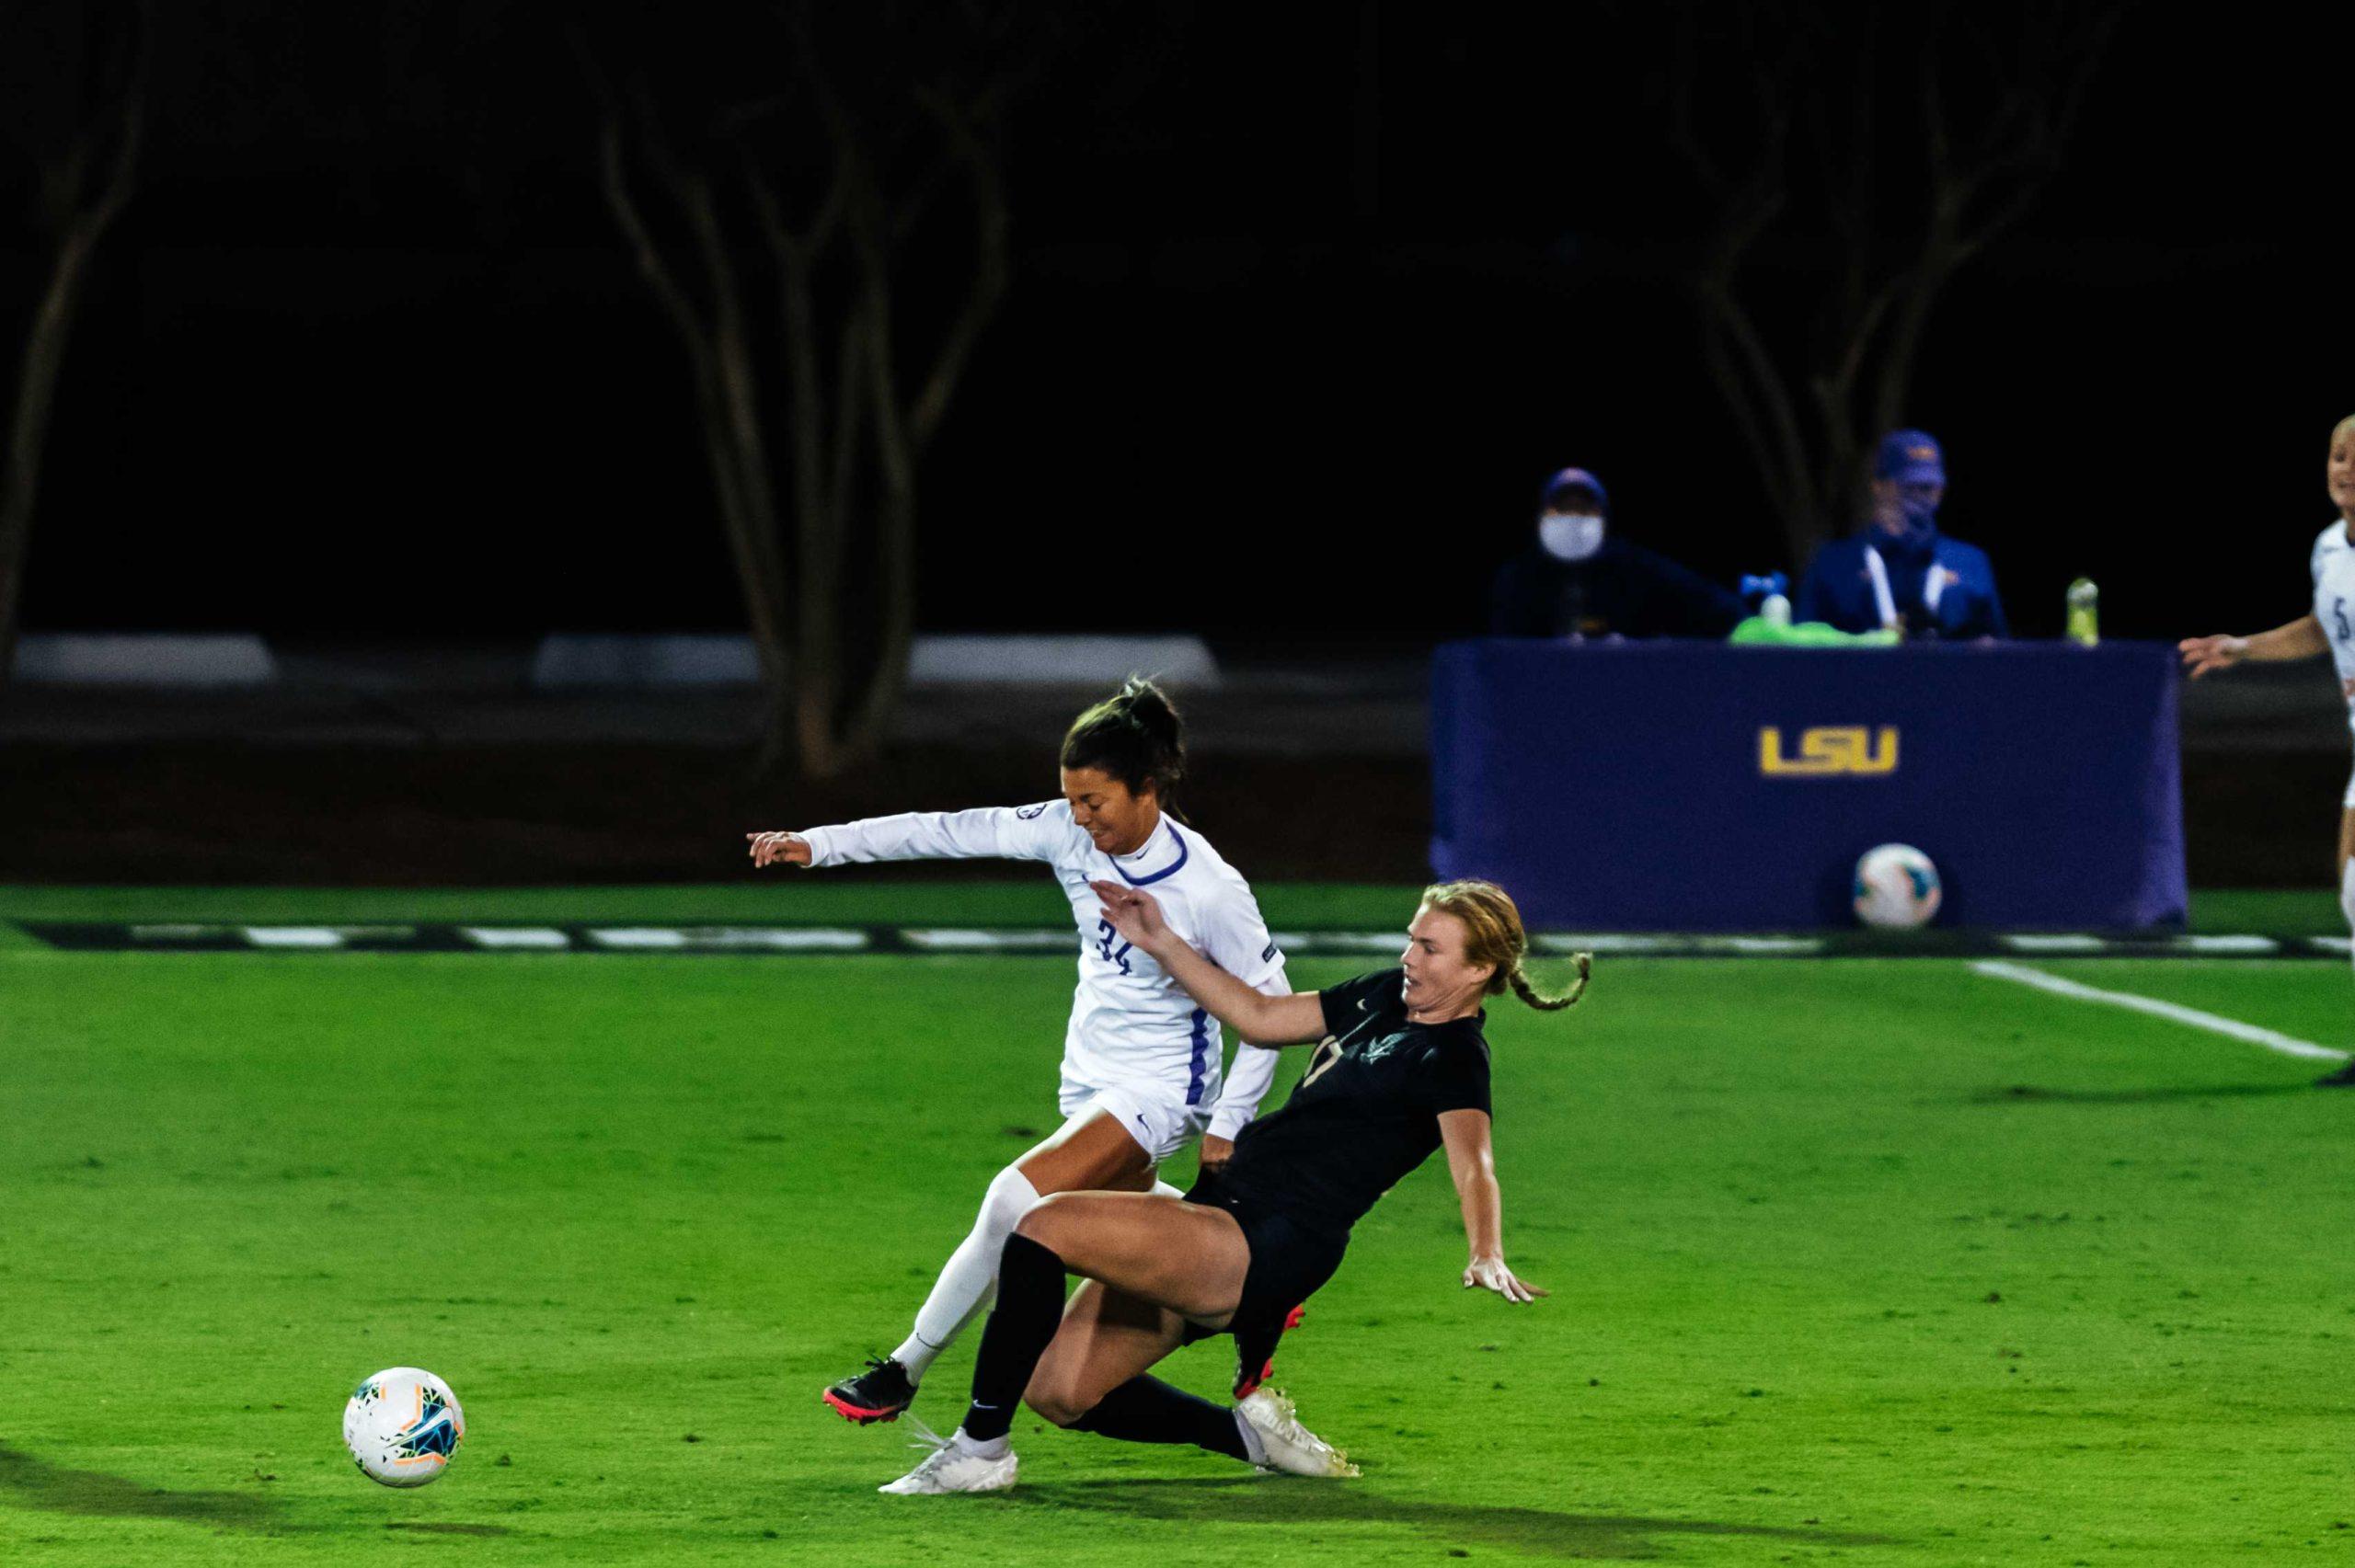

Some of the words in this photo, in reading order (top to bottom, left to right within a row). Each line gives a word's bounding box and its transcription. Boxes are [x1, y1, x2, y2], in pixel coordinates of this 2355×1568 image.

[2333, 596, 2351, 639] 5
[1759, 726, 1901, 776] LSU
[1096, 919, 1133, 975] 34
